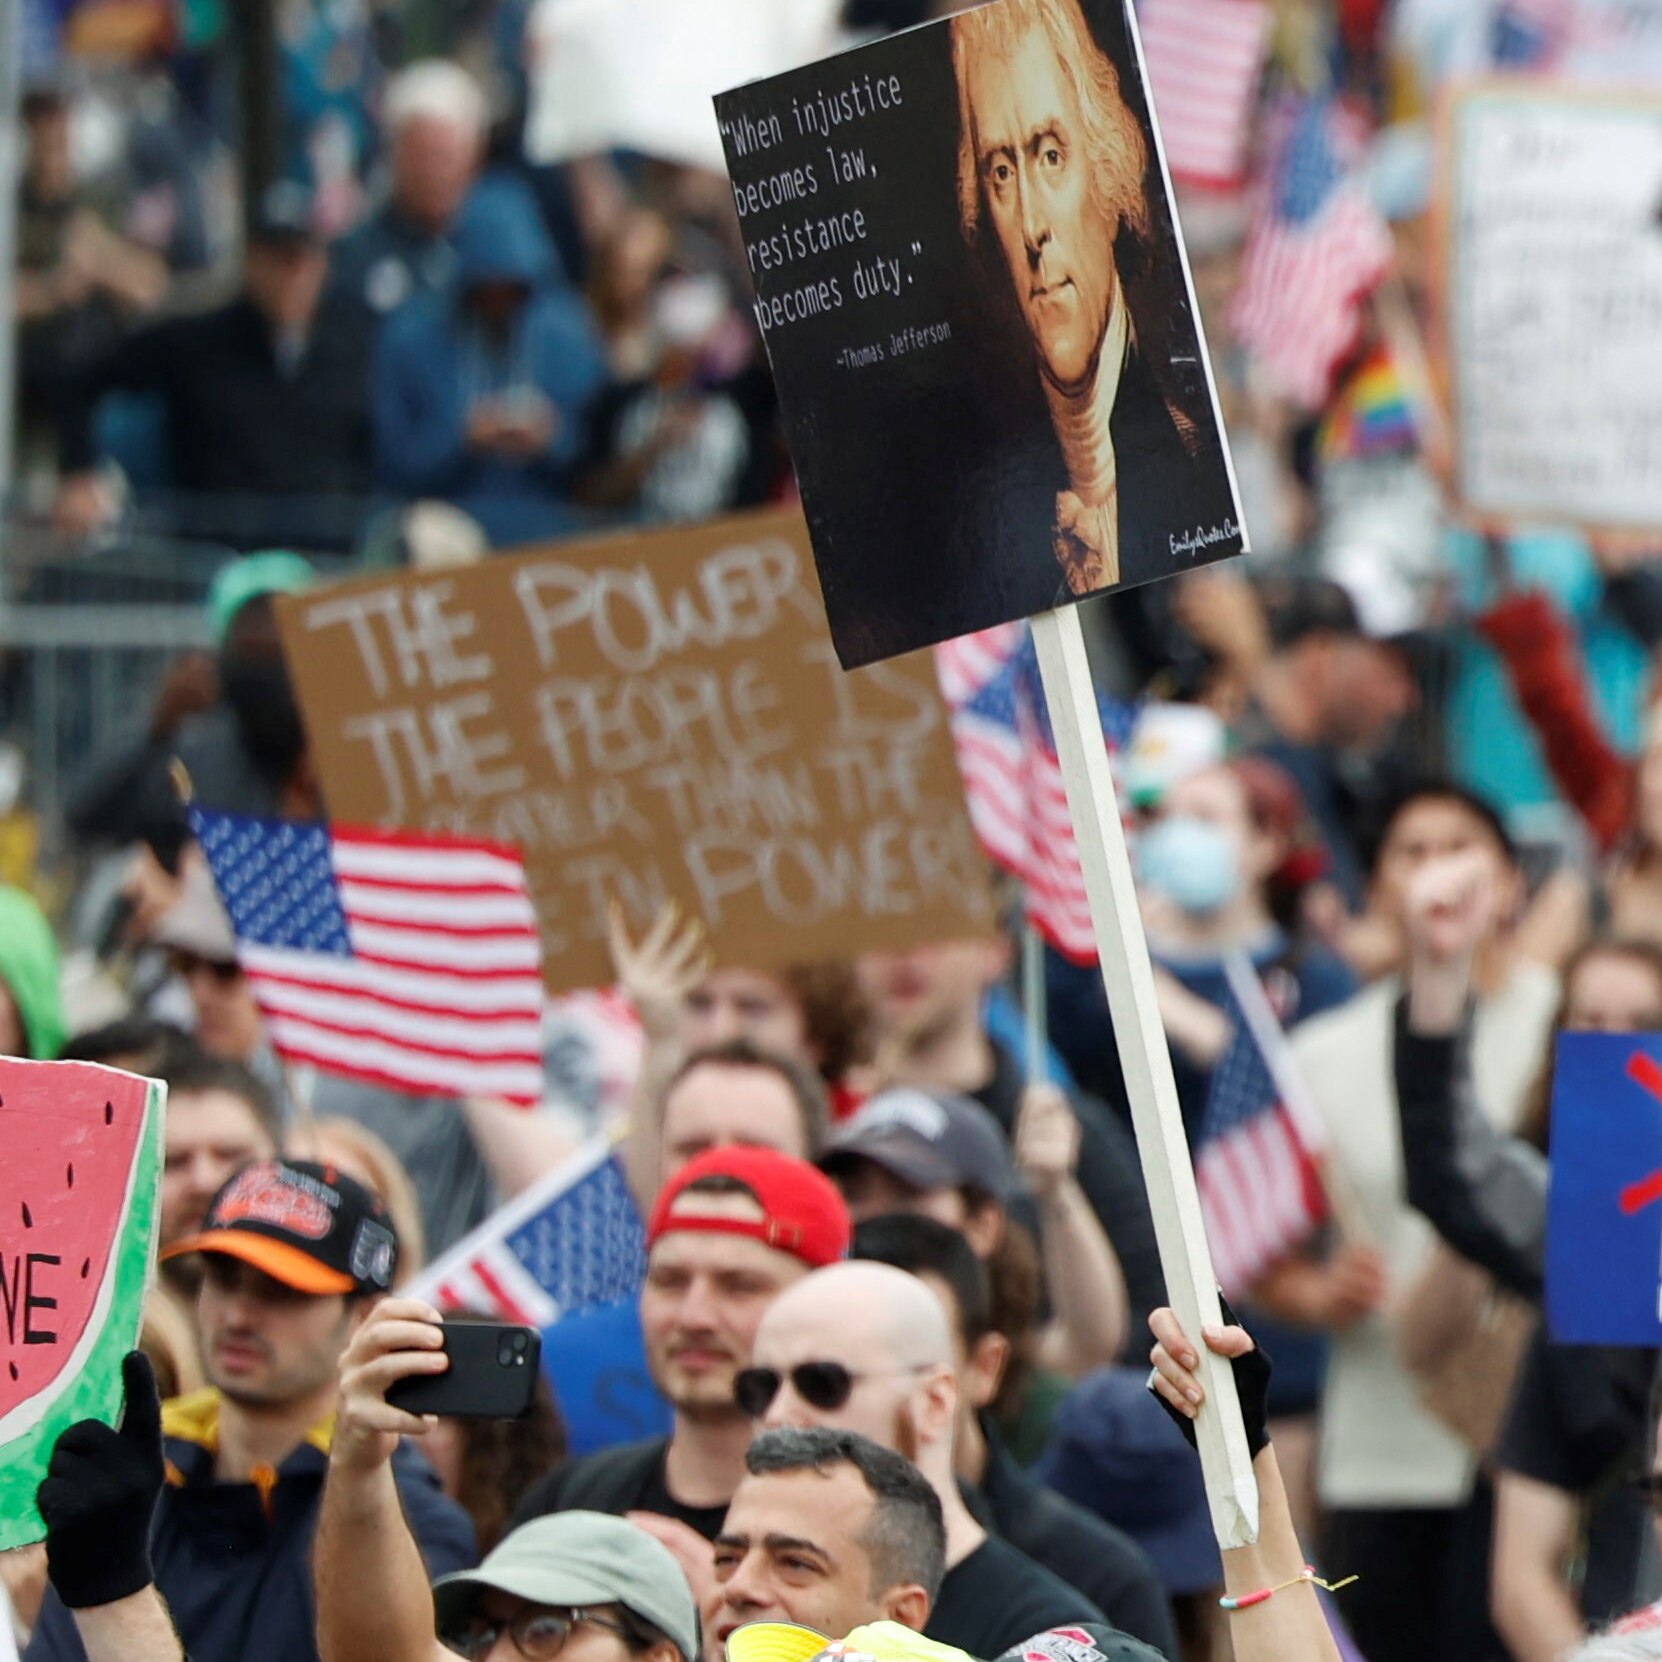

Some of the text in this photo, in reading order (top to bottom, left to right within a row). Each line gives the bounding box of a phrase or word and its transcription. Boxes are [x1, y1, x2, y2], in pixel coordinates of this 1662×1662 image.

[721, 74, 902, 157] “When injustice
[732, 146, 877, 217] becomes law,
[747, 208, 867, 273] resistance
[757, 241, 922, 330] becomes duty.”
[890, 321, 952, 357] Jefferson
[306, 538, 805, 700] THE POWER
[343, 690, 526, 825] THE
[537, 658, 794, 780] PEOPLE
